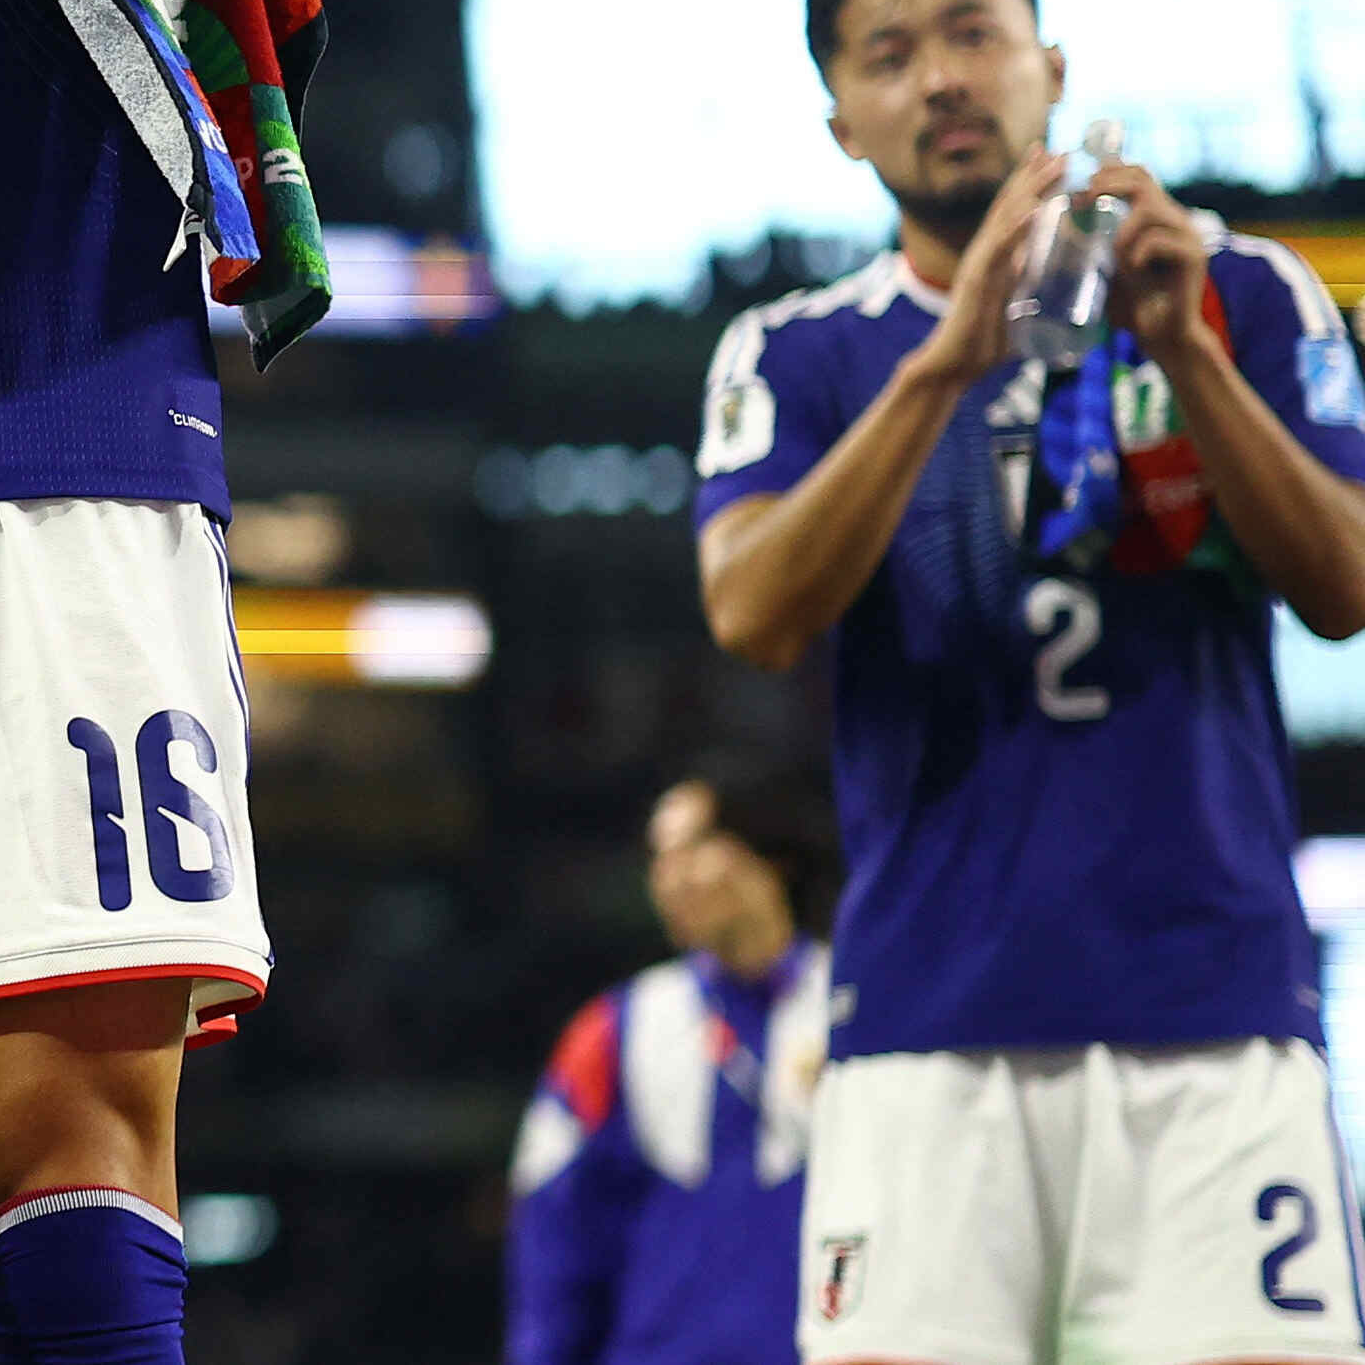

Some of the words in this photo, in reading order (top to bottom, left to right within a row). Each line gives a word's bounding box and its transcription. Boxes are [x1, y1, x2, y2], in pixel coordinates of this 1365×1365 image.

[1025, 577, 1110, 722] 2
[67, 709, 235, 912] 16
[1254, 1184, 1325, 1313] 2
